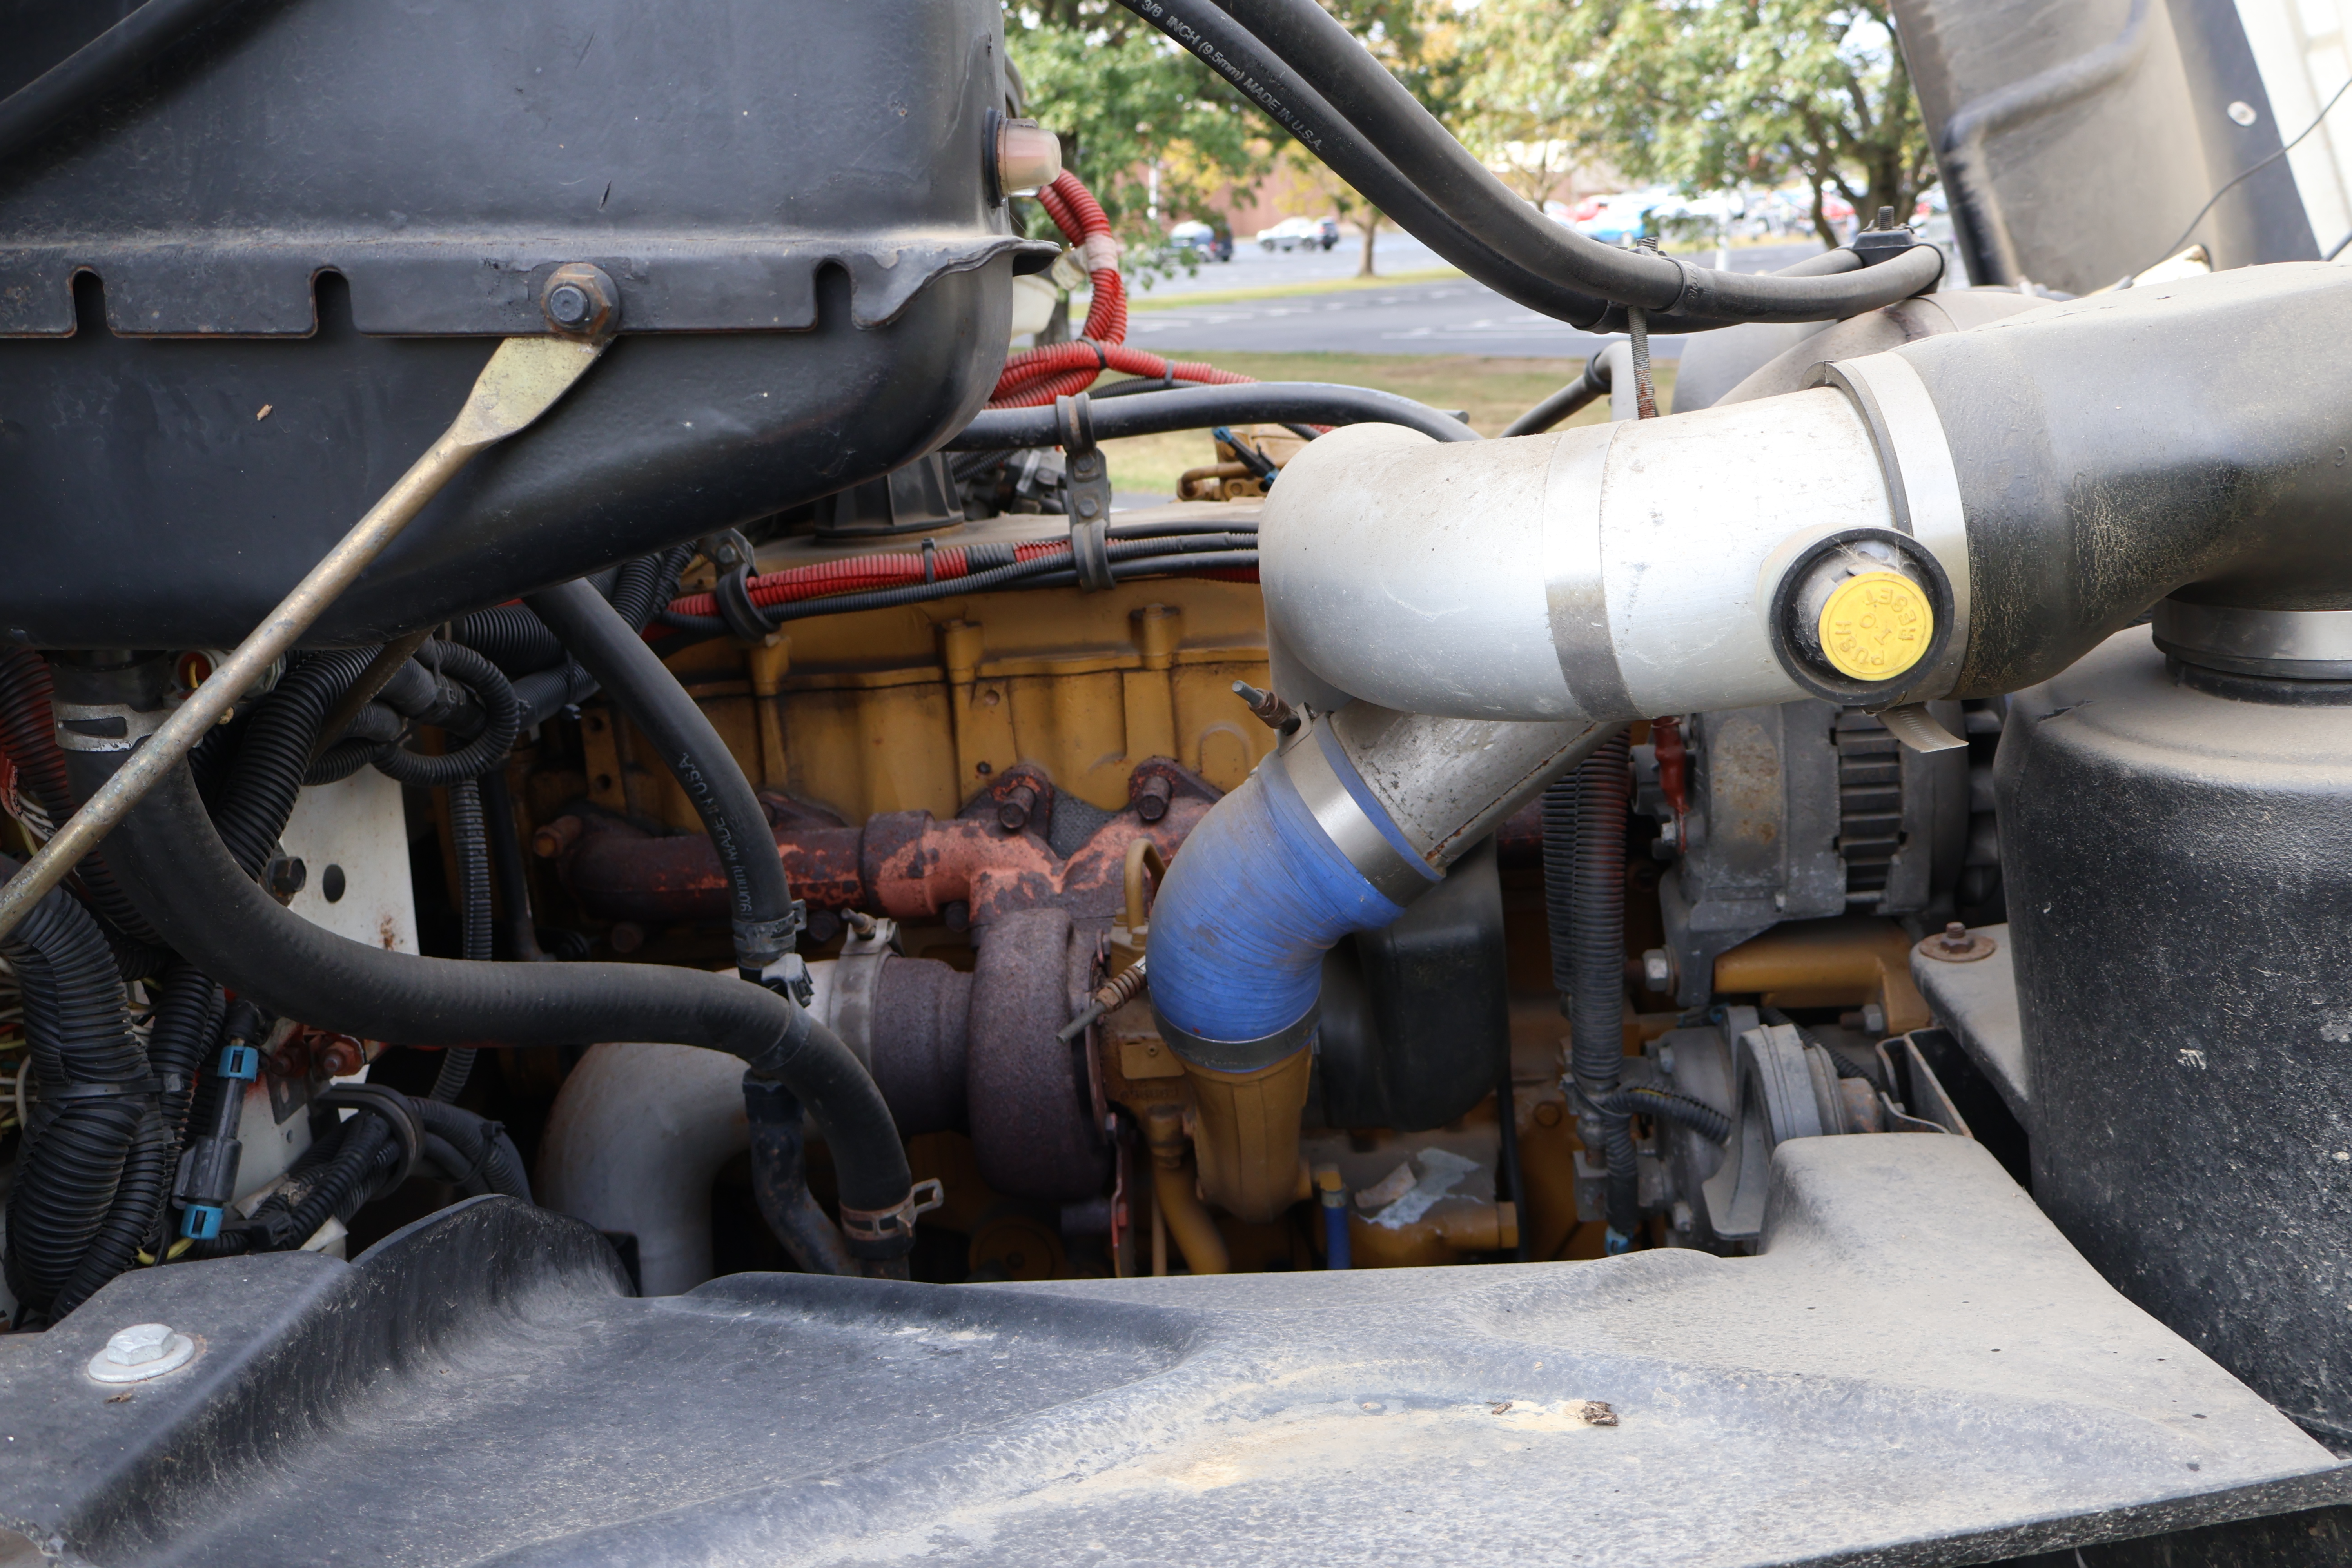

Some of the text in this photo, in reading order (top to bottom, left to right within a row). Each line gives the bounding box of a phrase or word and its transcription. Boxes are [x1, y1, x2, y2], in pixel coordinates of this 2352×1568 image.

[1141, 0, 1163, 18] 3/8
[1166, 15, 1201, 45] INCH
[1198, 41, 1245, 82] (9.5mm)
[1243, 78, 1281, 111] MADE
[1277, 107, 1294, 122] IN
[1859, 612, 1892, 645] TO
[1862, 588, 1917, 641] RESET
[1835, 621, 1884, 666] PUSH
[701, 797, 719, 815] IN
[711, 817, 738, 860] MADE
